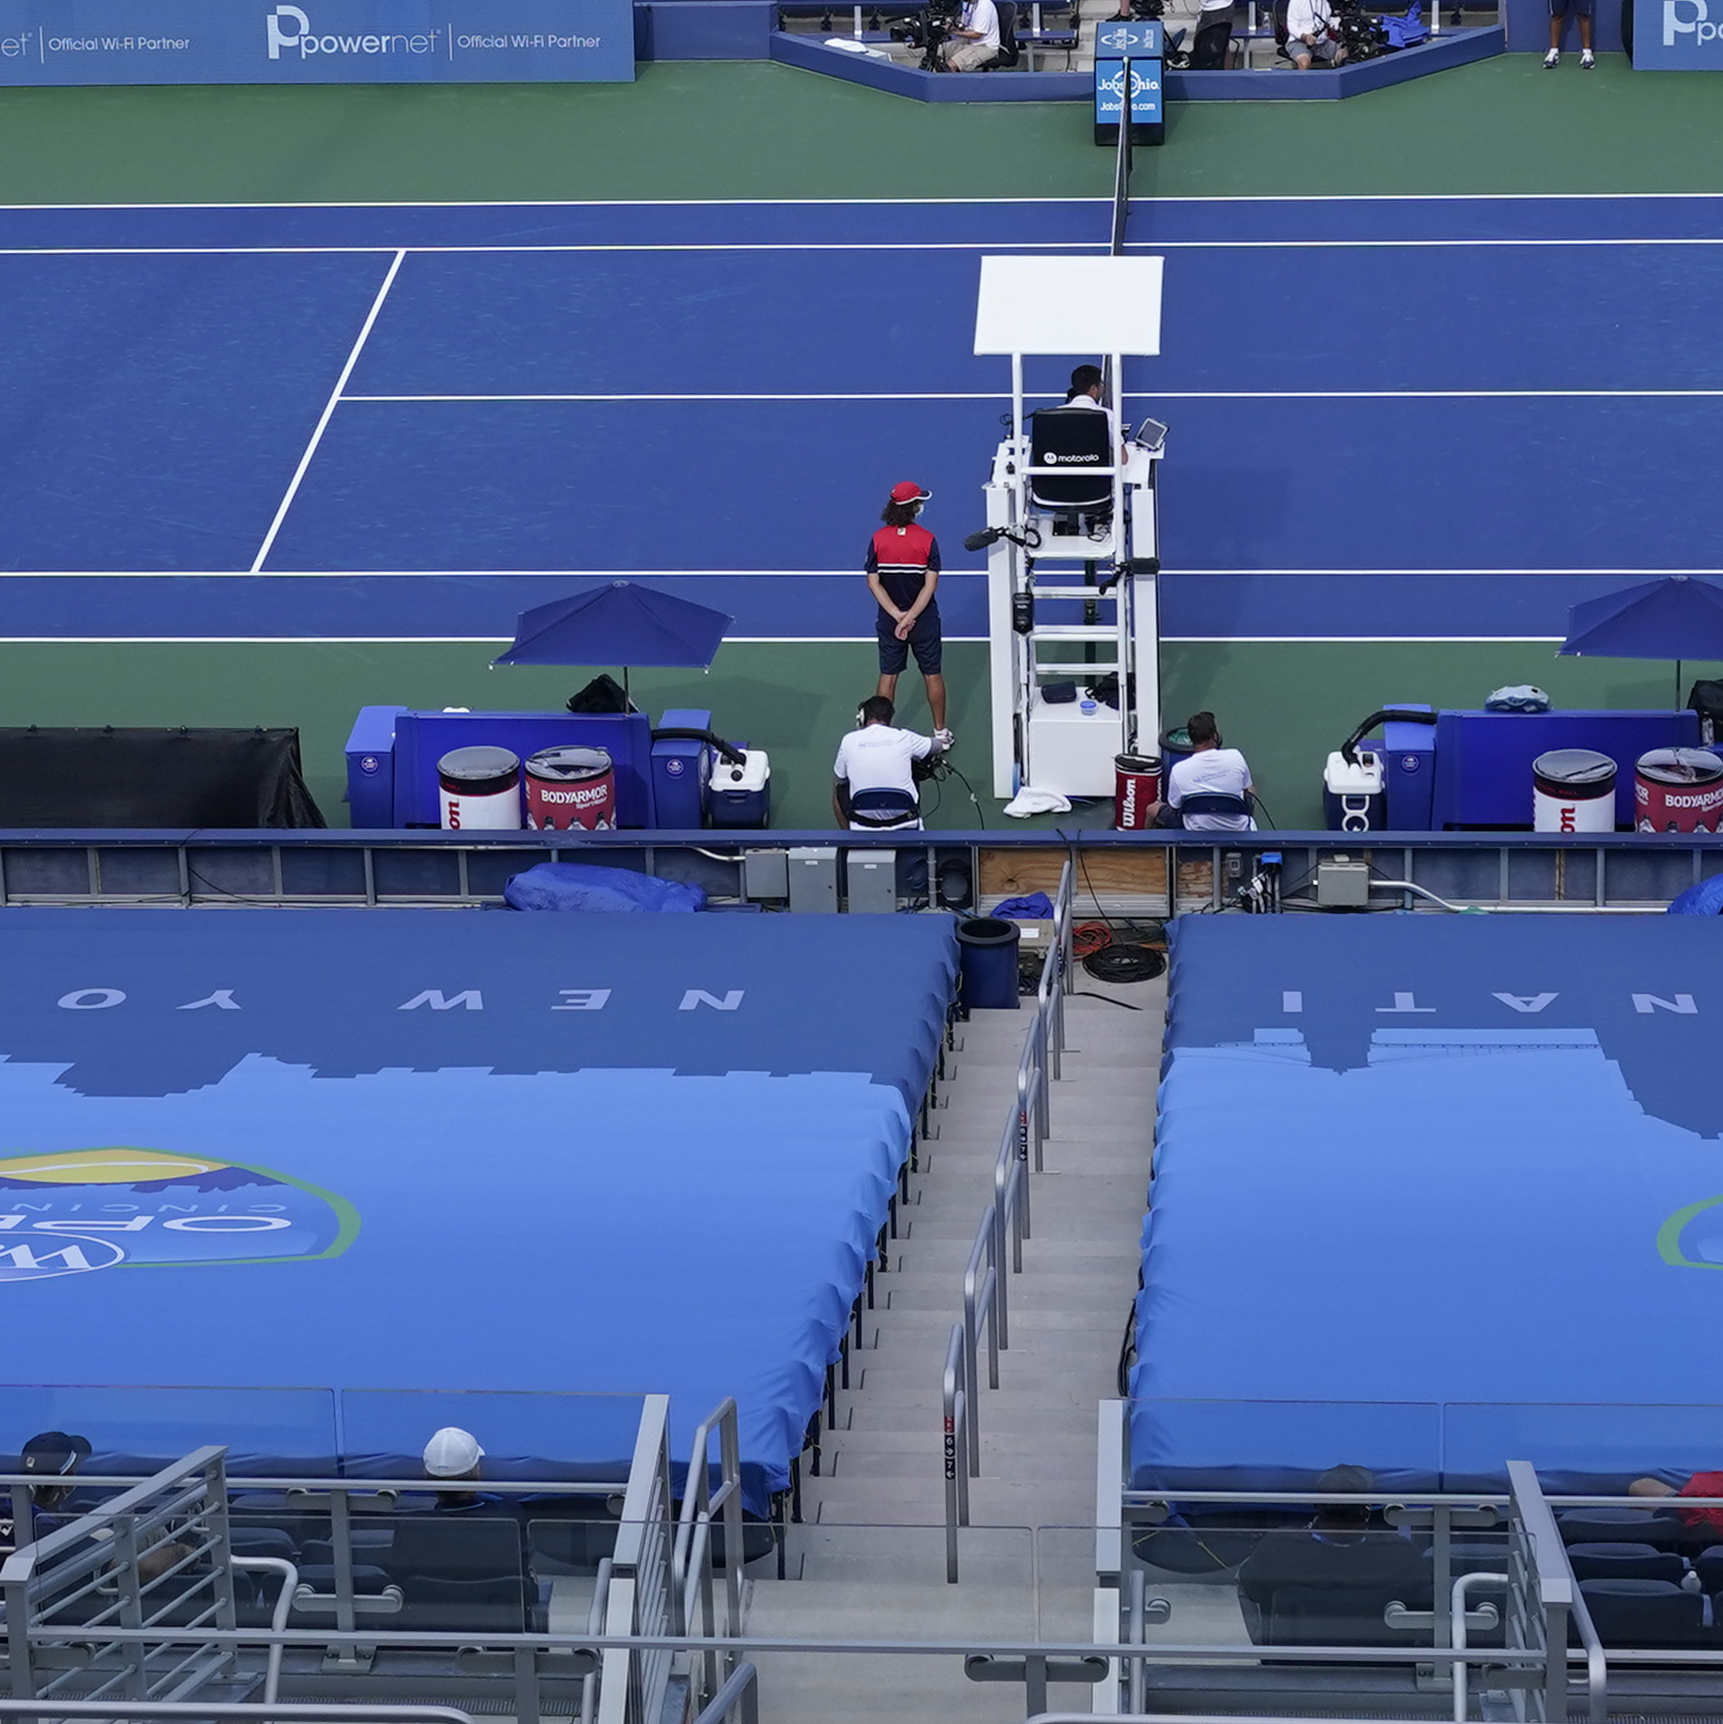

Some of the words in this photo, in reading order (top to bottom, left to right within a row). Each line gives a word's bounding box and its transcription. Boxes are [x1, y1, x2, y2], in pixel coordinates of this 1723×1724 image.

[49, 38, 99, 50] Official
[102, 37, 134, 49] Wi-Fi
[138, 37, 190, 49] Partner
[301, 31, 437, 59] powernet
[458, 36, 507, 48] Official
[511, 35, 544, 47] Wi-Fi
[548, 35, 601, 47] Partner
[1100, 102, 1156, 111] Jobso.com
[1057, 453, 1100, 464] motorola
[541, 784, 608, 805] BODYARMOR
[1122, 777, 1136, 827] Wilson
[397, 988, 746, 1012] NEW
